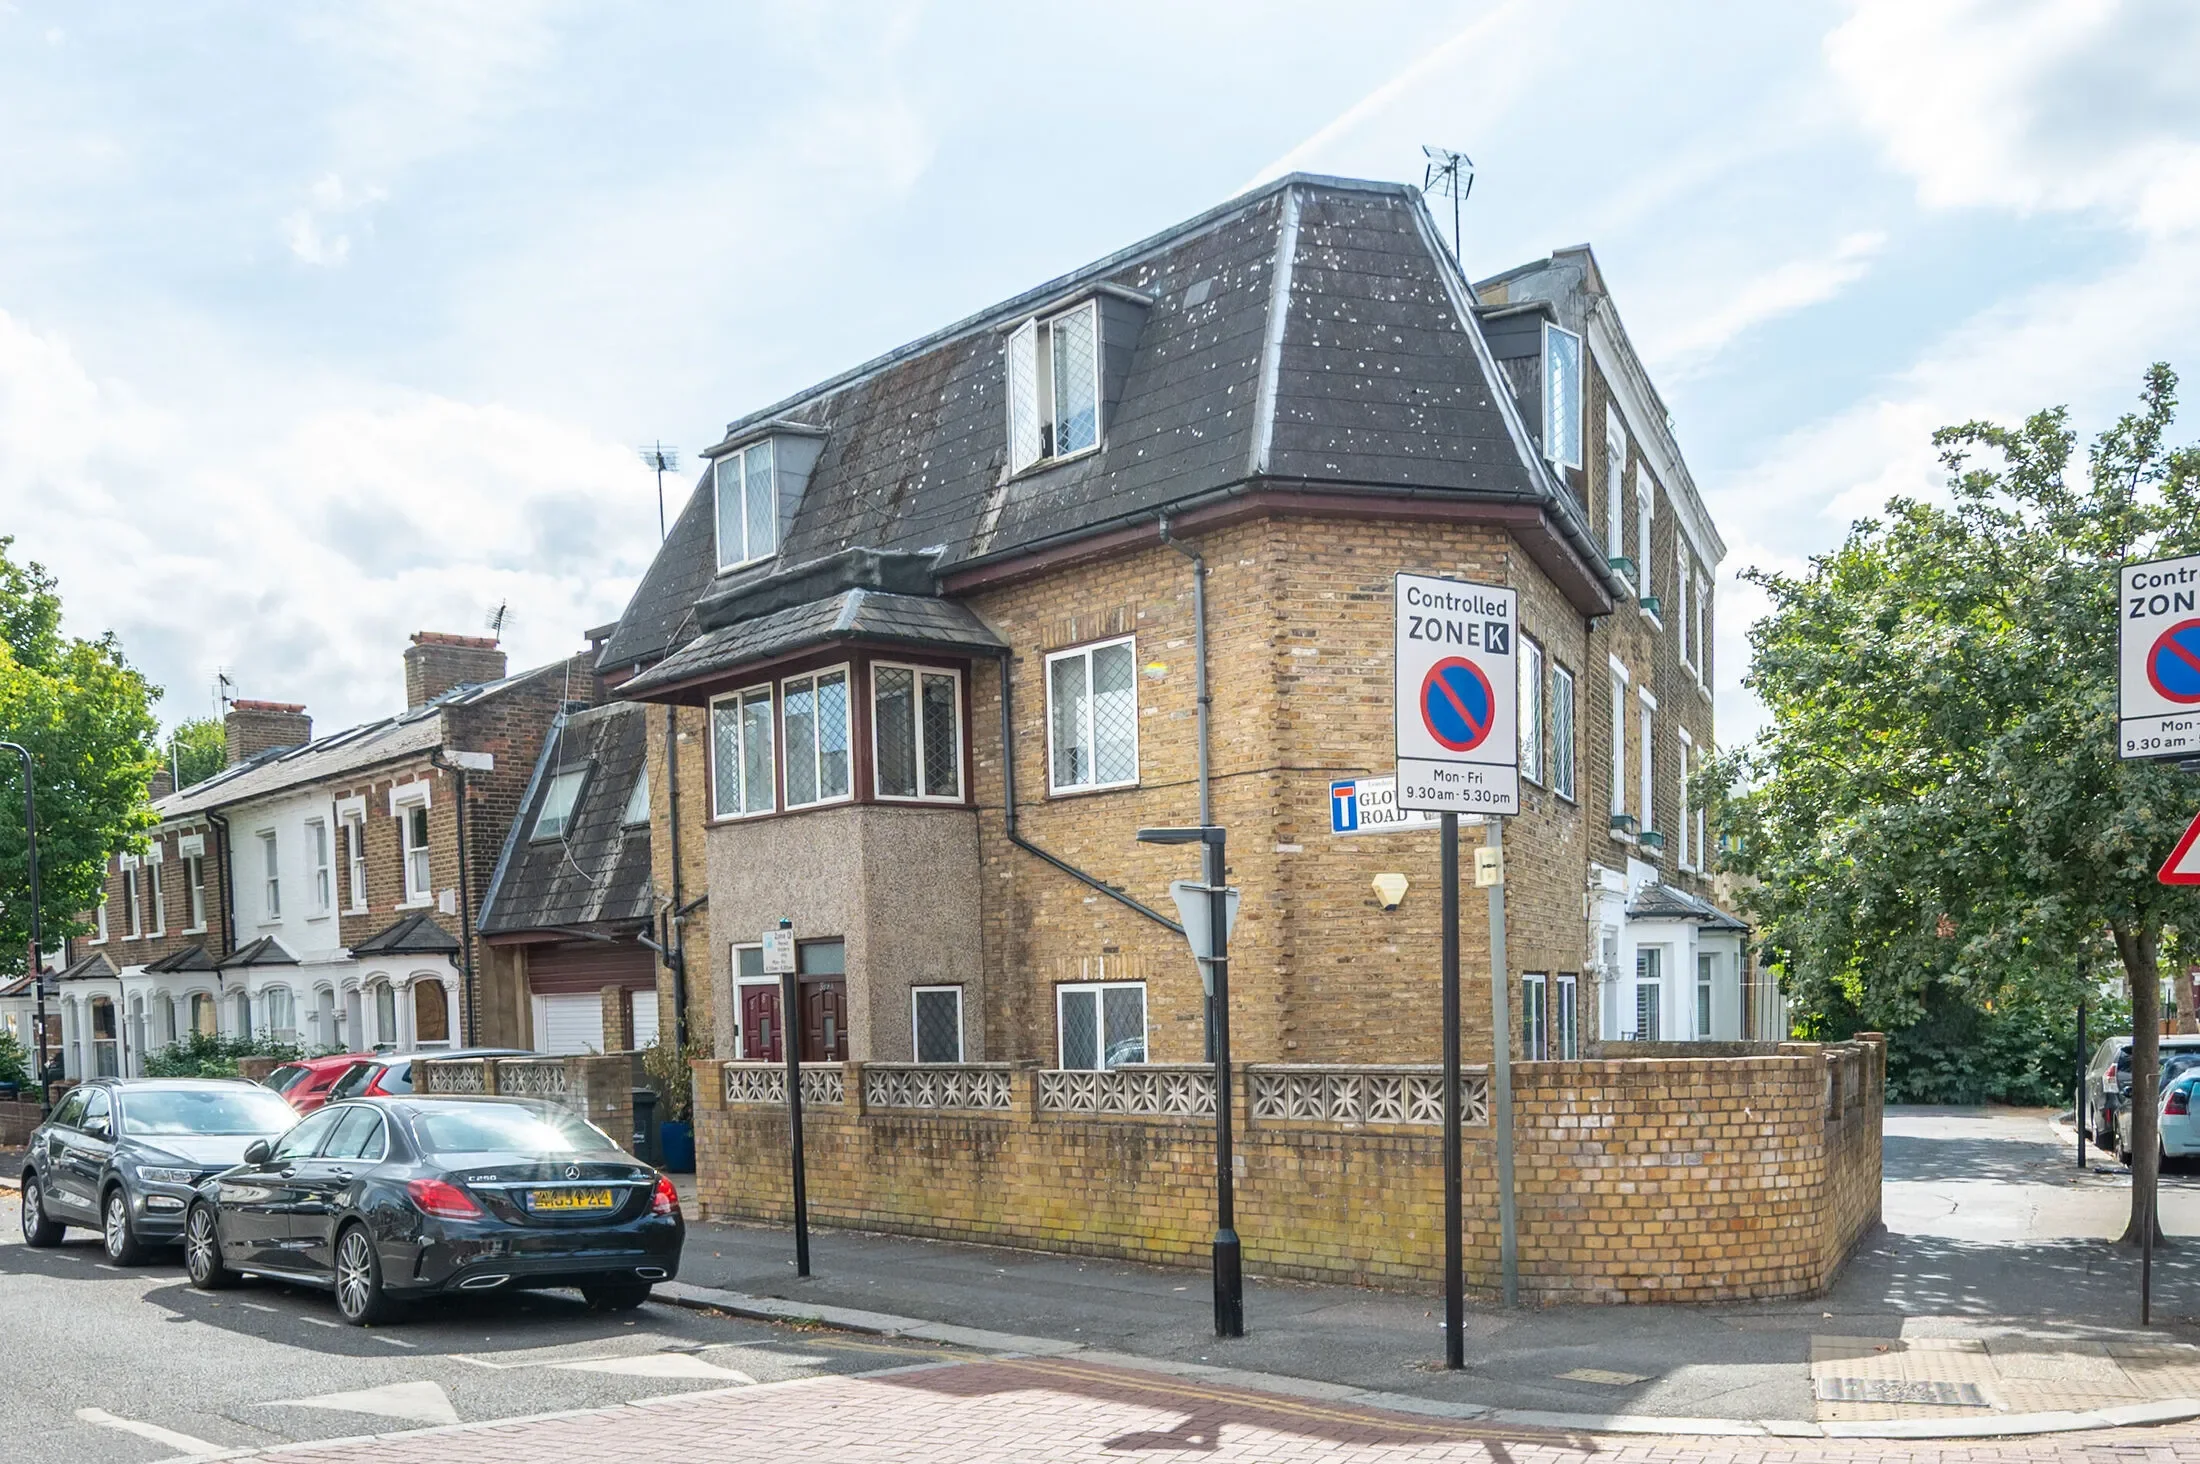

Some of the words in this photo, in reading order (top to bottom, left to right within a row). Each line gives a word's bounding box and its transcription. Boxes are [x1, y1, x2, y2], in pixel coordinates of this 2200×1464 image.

[2131, 566, 2200, 590] Contr
[1407, 586, 1508, 618] Controlled
[1408, 615, 1481, 647] ZONE
[1488, 624, 1505, 652] K
[2161, 720, 2193, 732] Mon
[1359, 790, 1397, 807] GLO
[1360, 808, 1408, 825] ROAD
